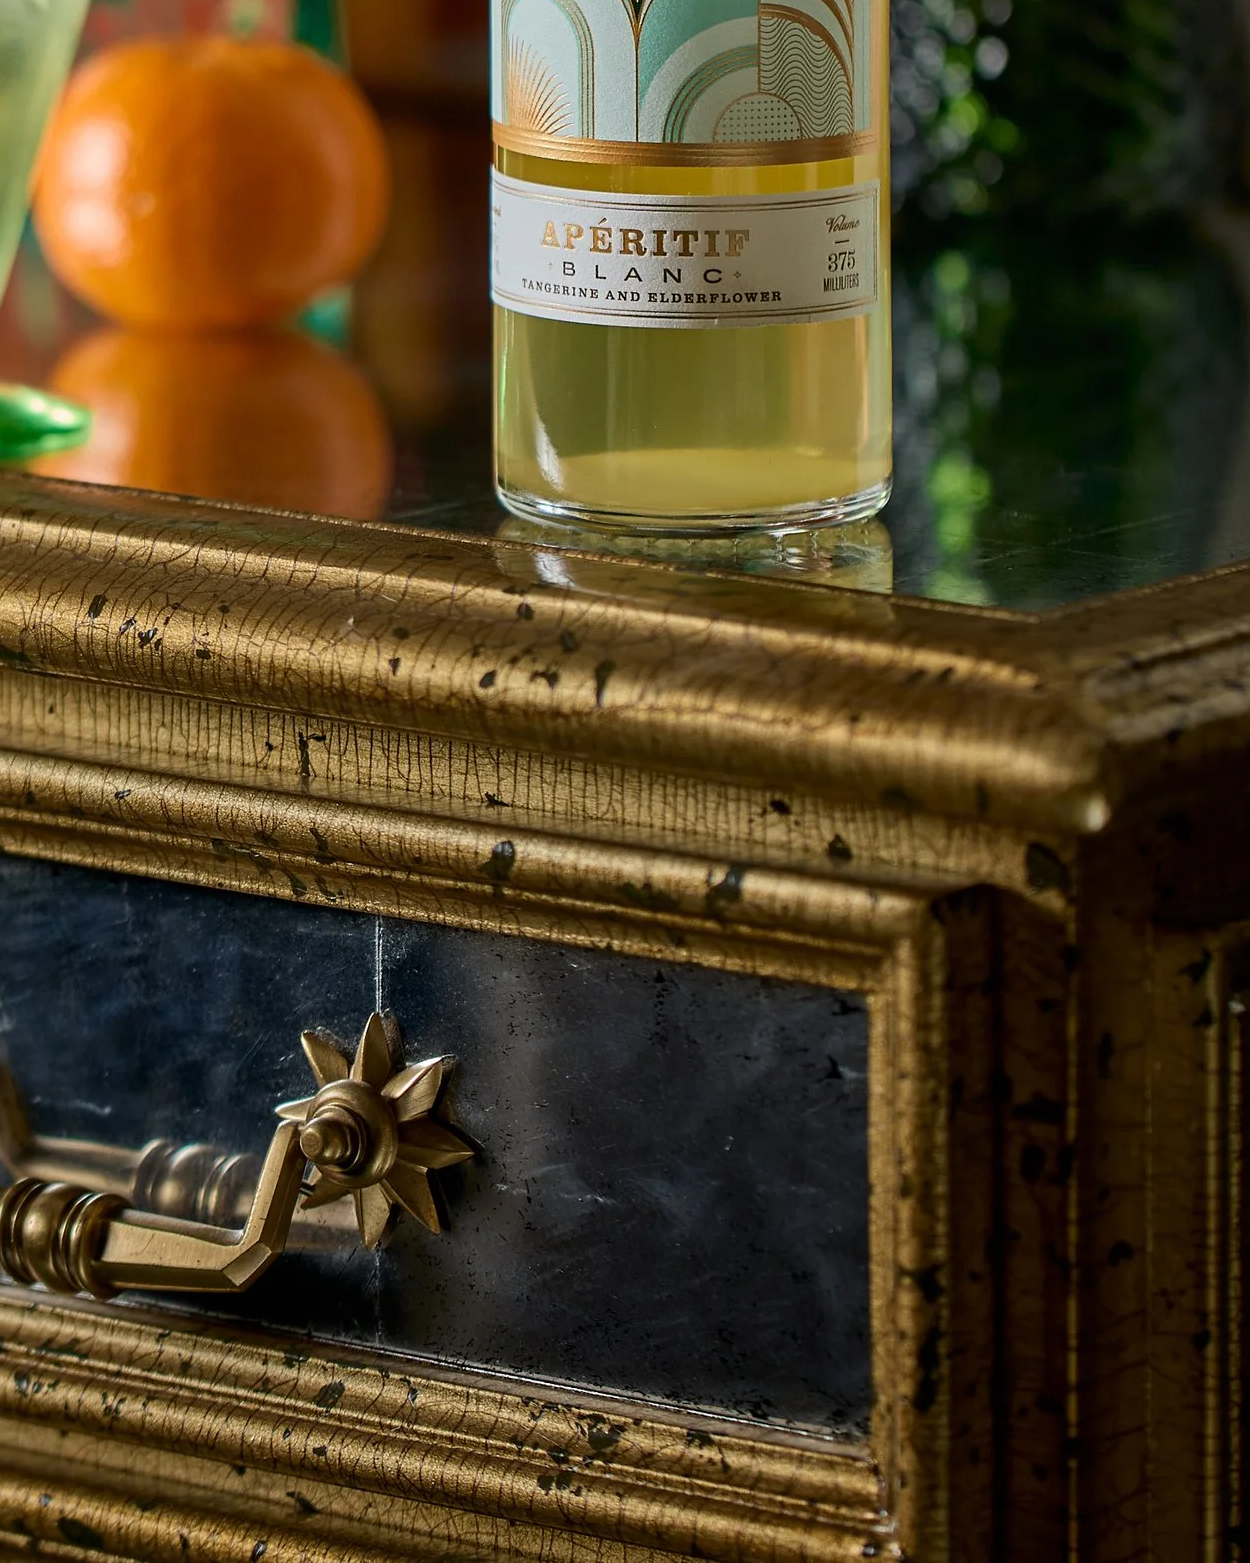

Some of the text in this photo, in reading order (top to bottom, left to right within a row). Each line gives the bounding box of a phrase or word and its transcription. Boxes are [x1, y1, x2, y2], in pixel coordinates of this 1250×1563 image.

[825, 214, 861, 234] Volume
[540, 217, 751, 258] APÉRITIF
[561, 261, 724, 285] BLANC
[827, 249, 856, 273] 375
[521, 278, 783, 304] TANGERINE AND ELDERFLOWER
[823, 272, 860, 293] MILLILITERS
